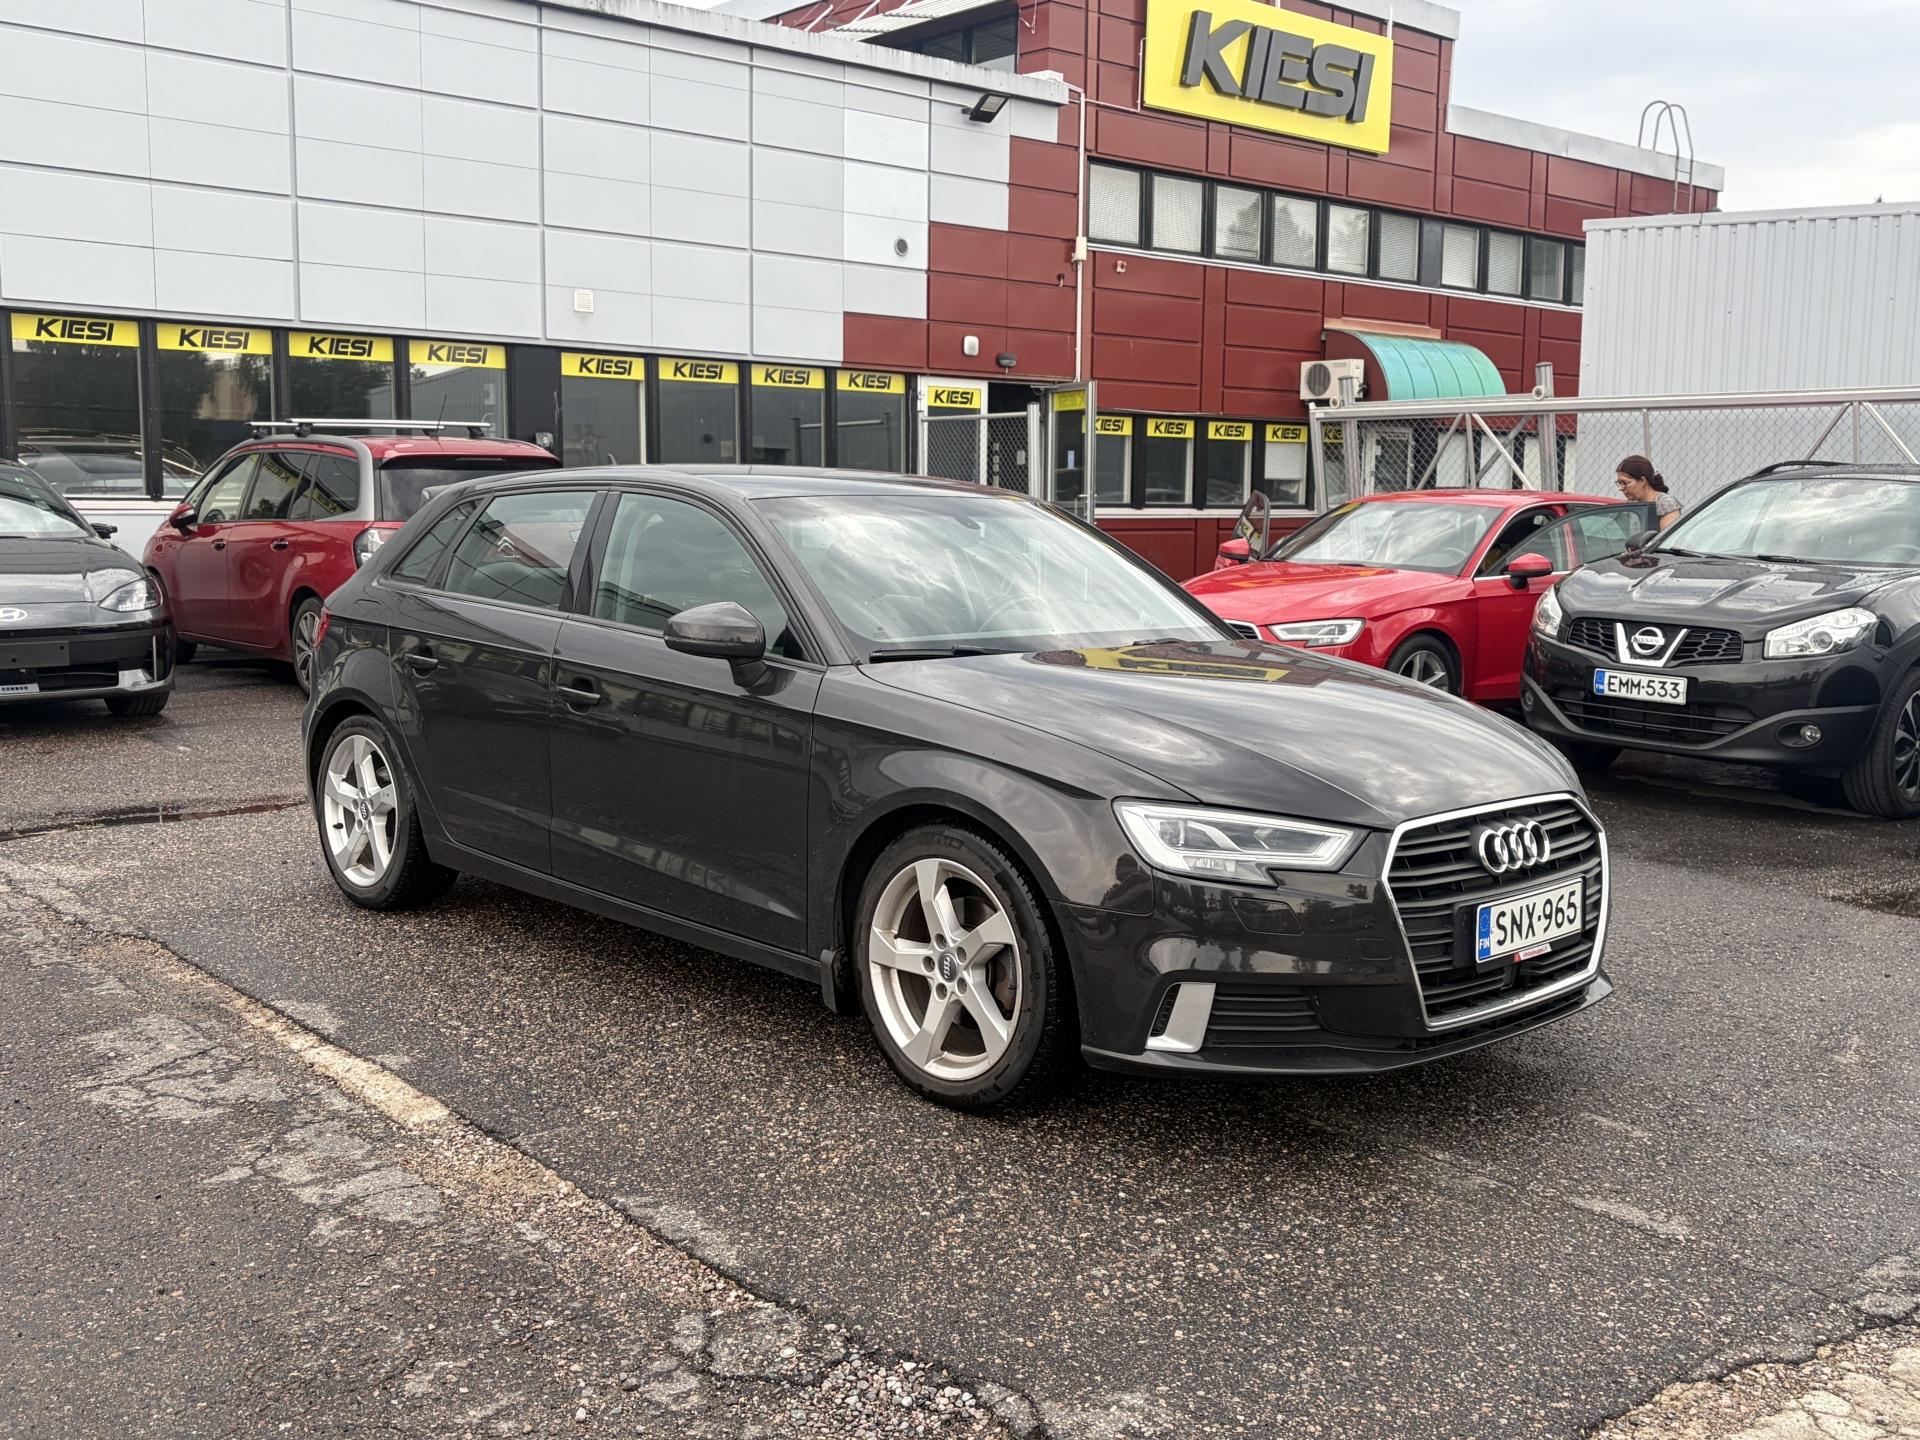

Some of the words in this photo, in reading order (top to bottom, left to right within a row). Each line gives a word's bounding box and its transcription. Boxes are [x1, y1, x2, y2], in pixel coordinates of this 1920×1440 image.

[1180, 9, 1375, 124] KIESI
[36, 317, 115, 342] KIESI
[178, 328, 250, 350] KIESI
[308, 336, 374, 358] KIESI
[427, 344, 488, 364] KIESI
[579, 357, 633, 376] KIESI
[673, 362, 723, 380] KIESI
[764, 367, 811, 386] KIESI
[848, 373, 891, 390] KIESI
[933, 389, 974, 405] KIESI
[1154, 419, 1187, 435] KIESI
[1214, 424, 1245, 438] KIESI
[1271, 427, 1302, 440] KIESI
[1324, 428, 1344, 440] KIE
[1632, 635, 1661, 645] NISSAN
[1606, 675, 1681, 699] EMM-533
[1495, 889, 1578, 947] SNX-965
[1480, 937, 1490, 950] FIN
